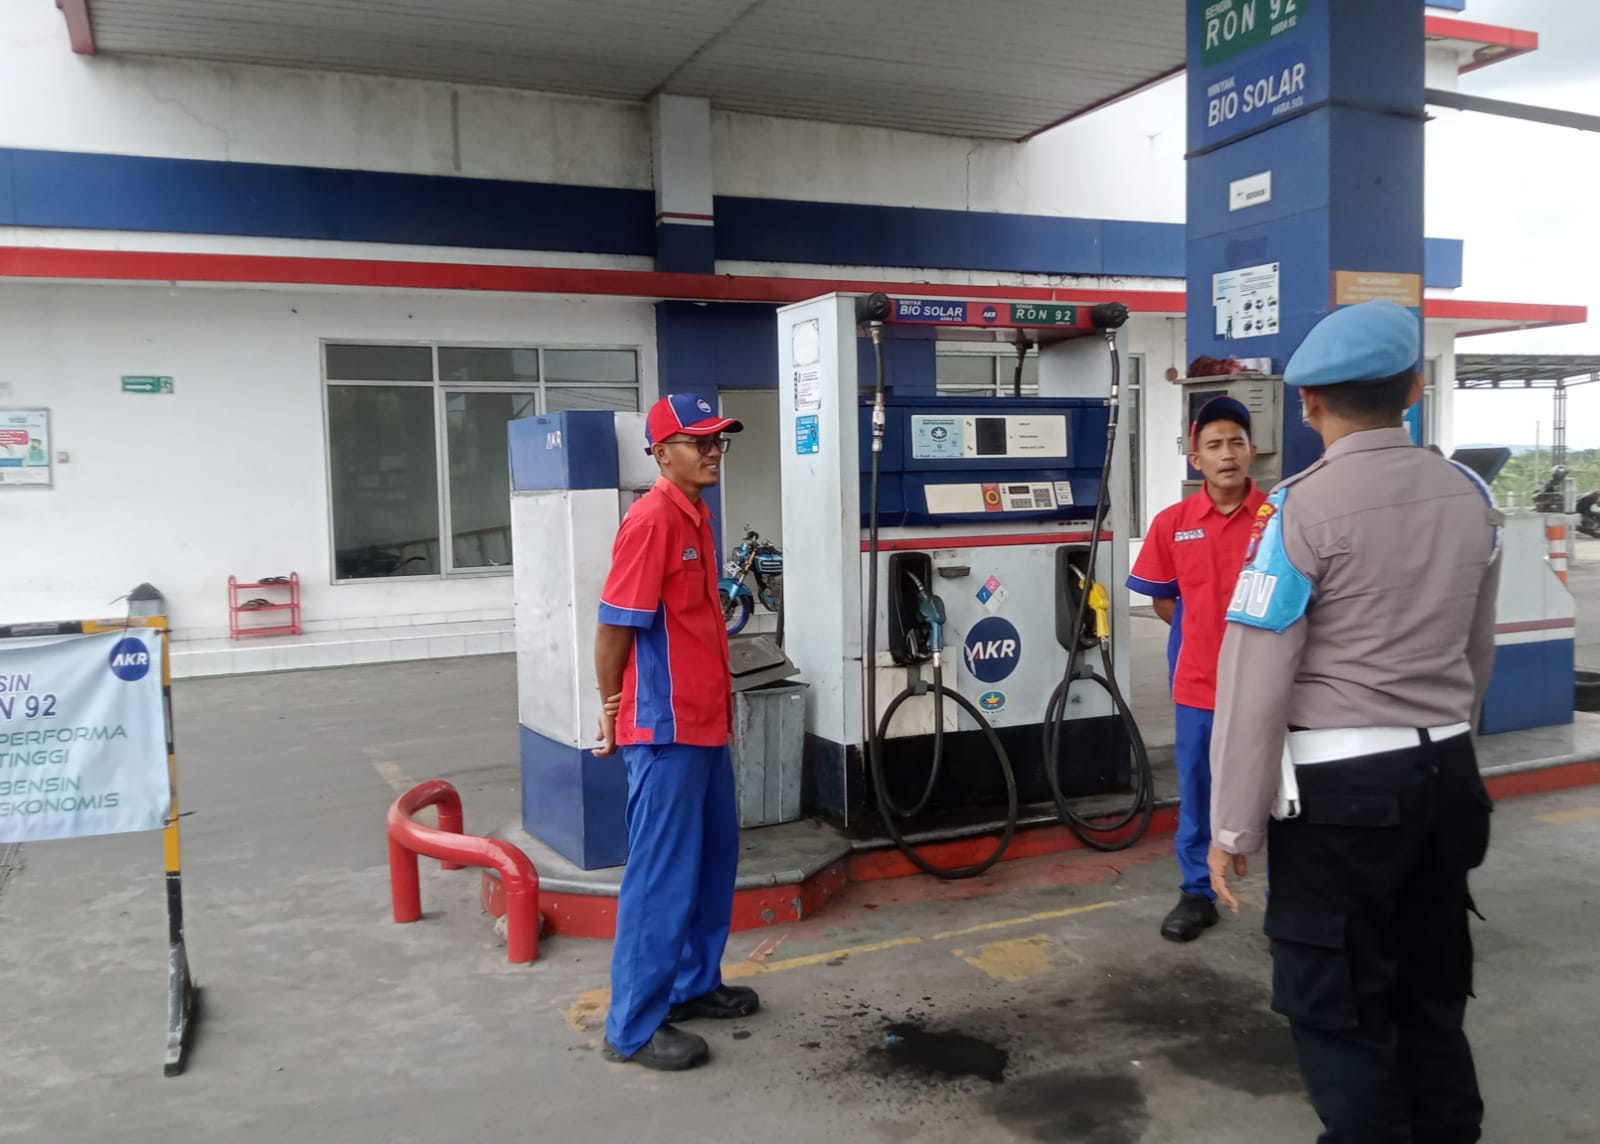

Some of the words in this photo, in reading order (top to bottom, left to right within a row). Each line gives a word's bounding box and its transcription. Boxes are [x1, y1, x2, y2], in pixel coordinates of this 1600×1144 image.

[1206, 0, 1255, 50] RON
[1207, 91, 1239, 127] BIO
[1242, 62, 1306, 113] SOLAR
[900, 305, 921, 316] BIO
[923, 306, 963, 317] SOLAR
[1016, 309, 1048, 320] RON
[1055, 310, 1071, 321] 92
[981, 591, 988, 600] 1
[989, 580, 996, 590] 2
[111, 652, 148, 667] AKR
[968, 639, 1016, 661] AKR
[24, 693, 57, 718] 92
[0, 724, 128, 746] PERFORMA
[0, 749, 69, 768] TINGGI
[0, 775, 81, 796] BENSIN
[0, 792, 120, 816] EKONOMIS
